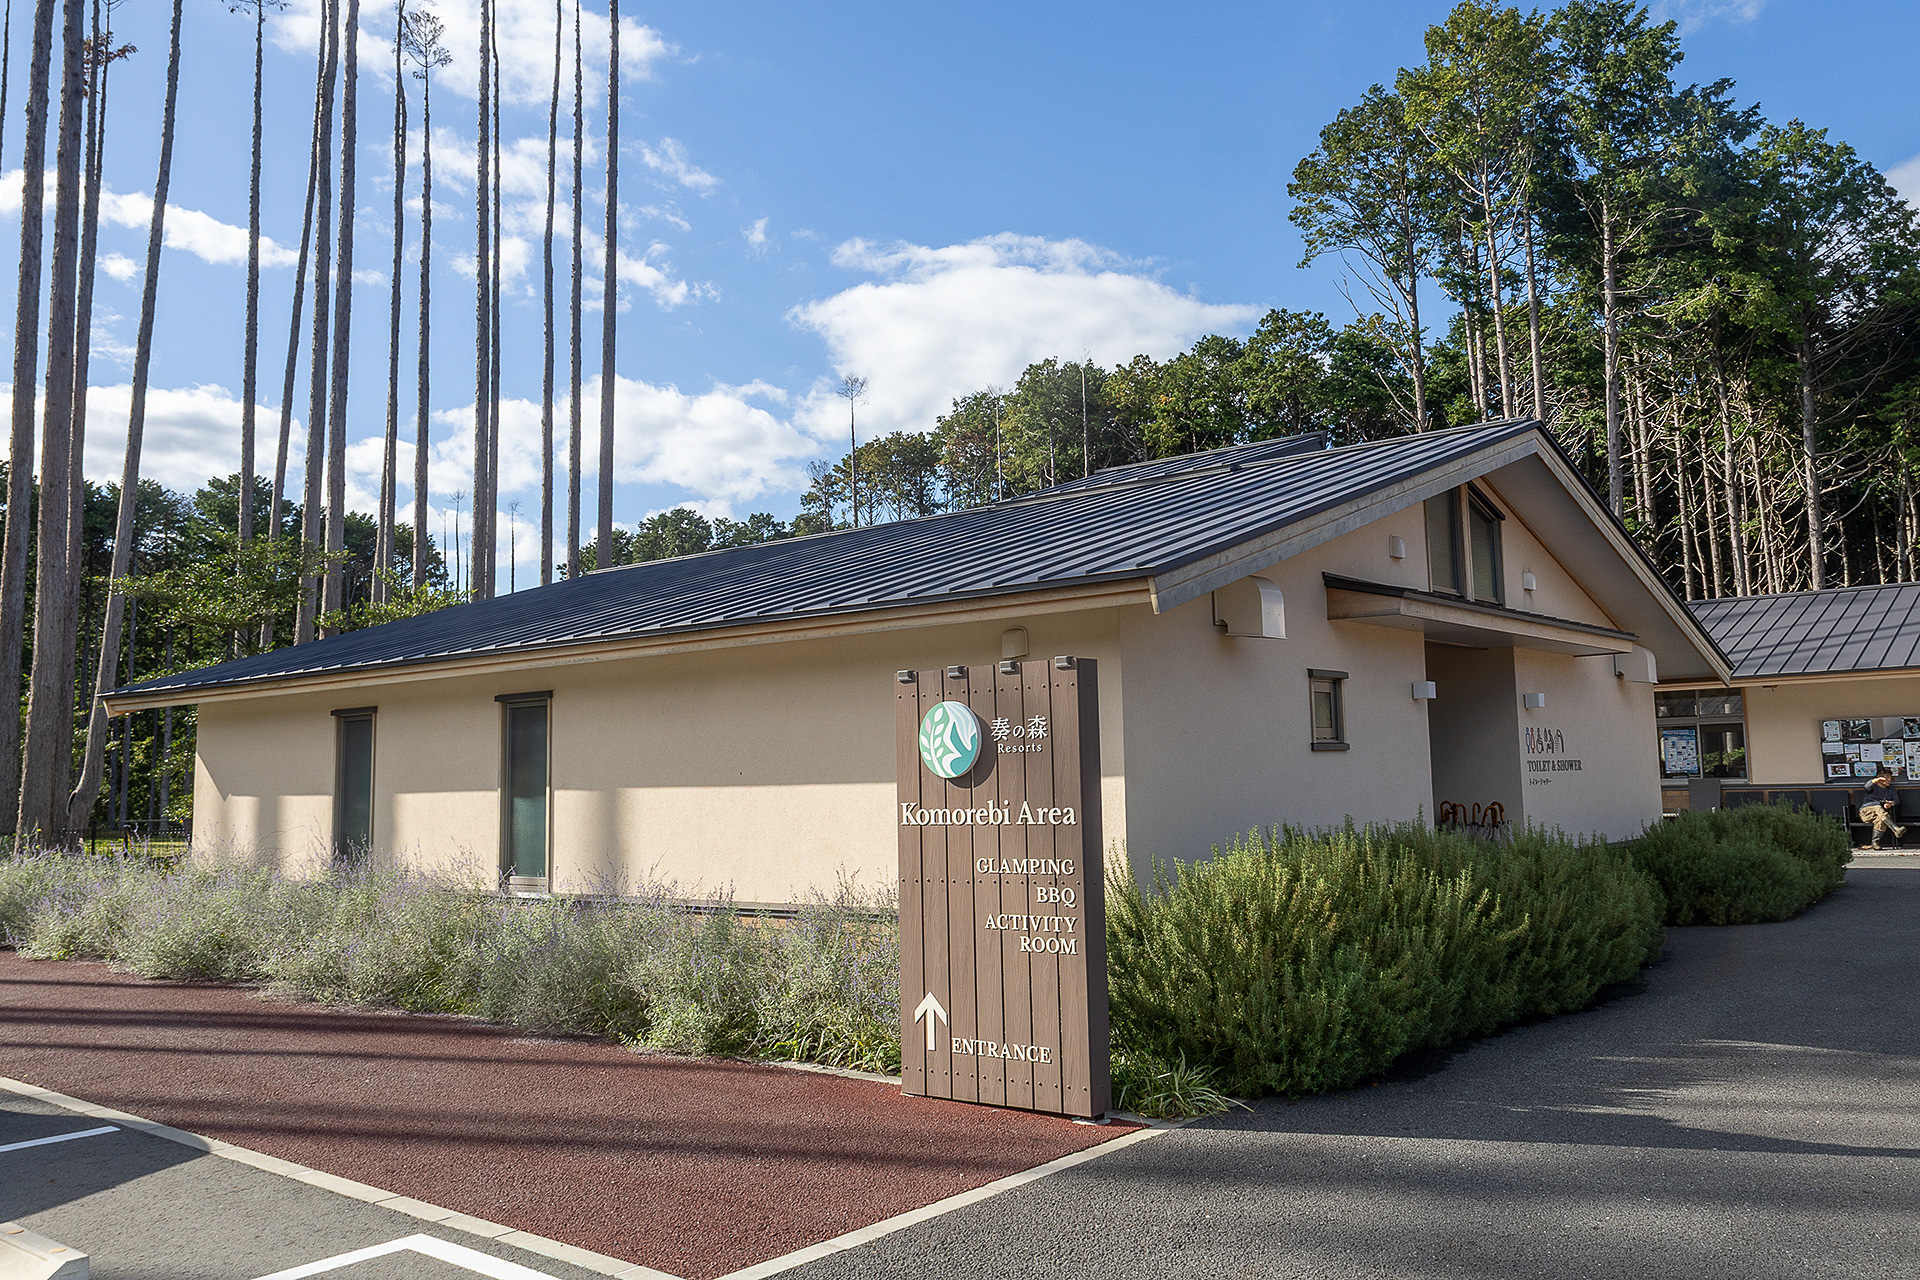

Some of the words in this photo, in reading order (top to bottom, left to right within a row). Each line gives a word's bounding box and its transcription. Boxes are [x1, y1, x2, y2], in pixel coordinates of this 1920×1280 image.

[990, 714, 1048, 742] 奏の森
[997, 742, 1043, 754] Resorts
[1527, 760, 1550, 772] TOILET
[1551, 760, 1557, 772] &
[1557, 759, 1582, 771] SHOWER
[900, 799, 1012, 826] Komorebi
[1015, 800, 1077, 826] Area
[976, 857, 1075, 876] GLAMPING
[1036, 886, 1077, 909] BBQ
[984, 913, 1078, 934] ACTIVITY
[1019, 935, 1078, 956] ROOM
[951, 1037, 1052, 1064] ENTRANCE
